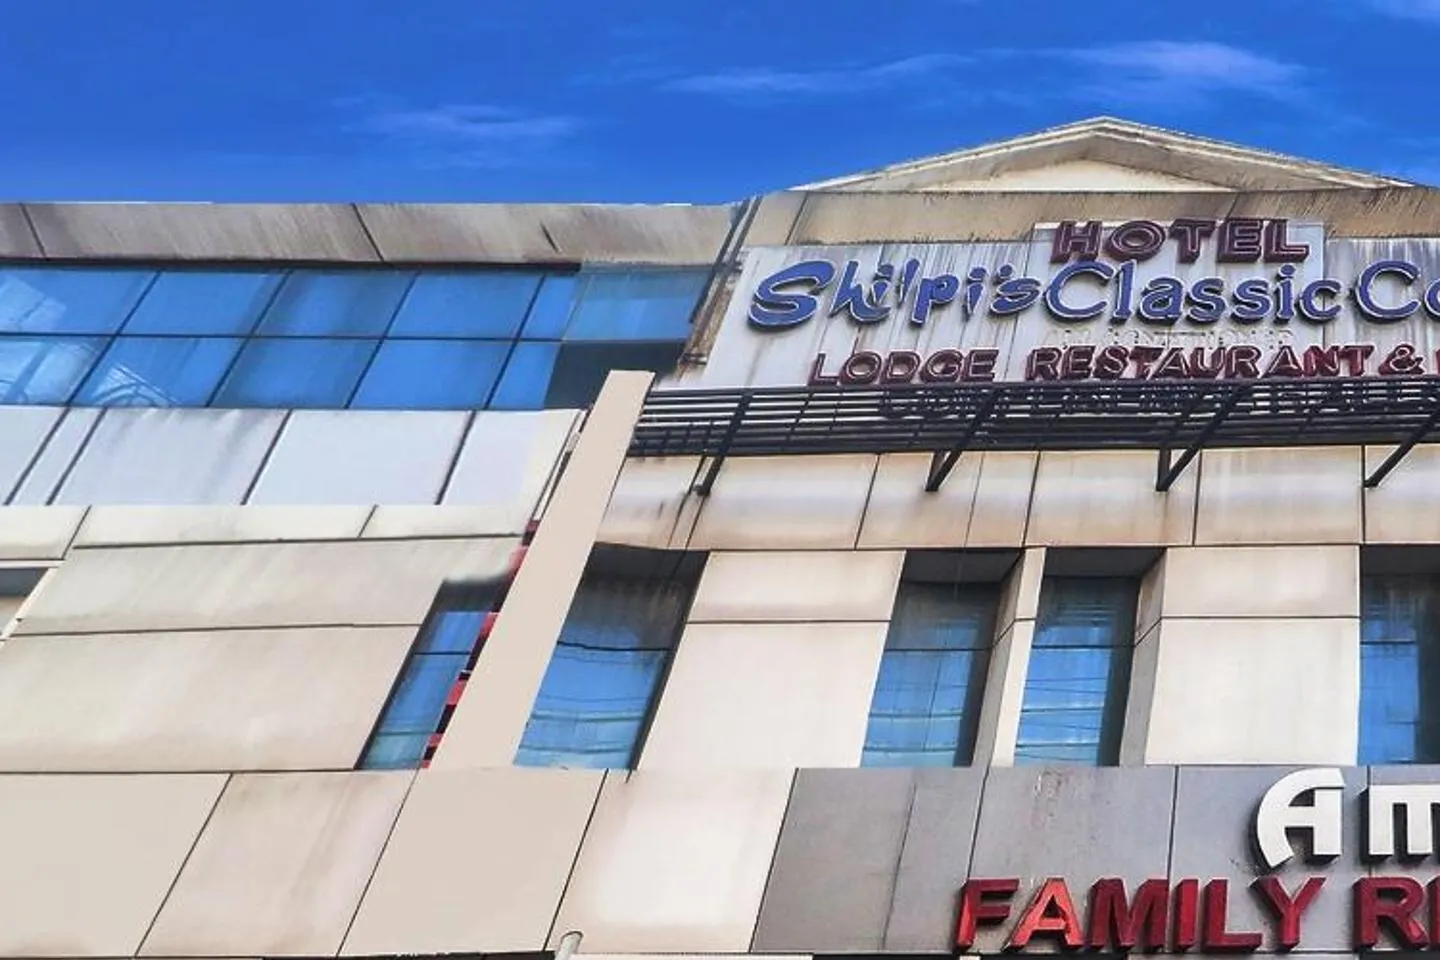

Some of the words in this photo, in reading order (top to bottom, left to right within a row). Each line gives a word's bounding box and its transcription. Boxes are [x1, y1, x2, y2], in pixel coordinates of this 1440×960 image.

[1051, 218, 1309, 262] HOTEL
[1043, 259, 1343, 325] Classic
[807, 347, 999, 386] LODGE
[1025, 343, 1374, 381] RESTAURANT
[1378, 343, 1425, 375] &
[954, 875, 1328, 952] FAMILY
